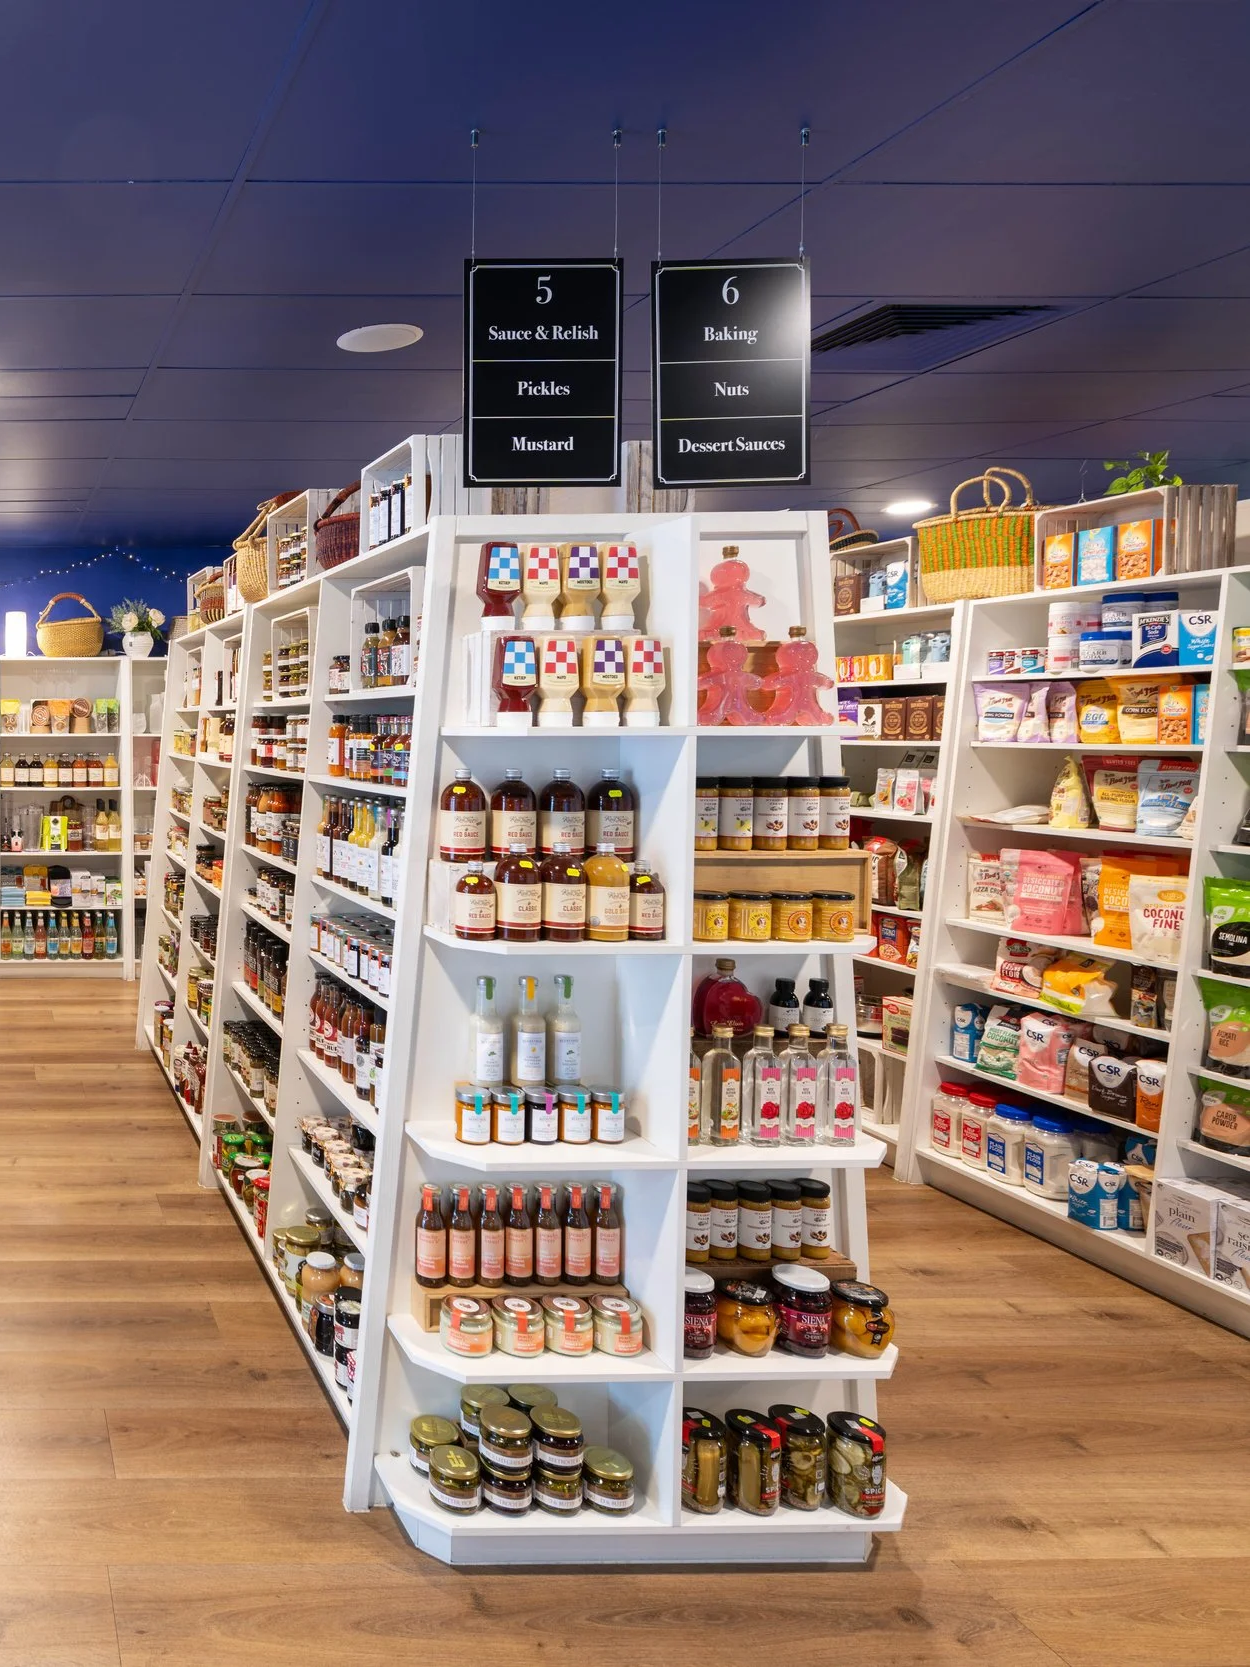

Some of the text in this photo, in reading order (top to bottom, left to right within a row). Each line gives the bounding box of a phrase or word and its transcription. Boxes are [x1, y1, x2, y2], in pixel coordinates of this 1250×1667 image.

[536, 275, 552, 305] 5
[722, 276, 739, 305] 6
[488, 325, 599, 341] Sauce & Relish
[703, 327, 758, 344] Baking
[517, 381, 570, 396] Pickles
[714, 382, 749, 397] Nuts
[512, 436, 574, 451] Mustard
[678, 437, 785, 453] Dessert Sauces
[1188, 615, 1212, 626] CSR
[1021, 884, 1064, 895] COCONUT
[1152, 919, 1180, 930] FINE
[1218, 932, 1248, 944] SEMOLINA
[1026, 1030, 1045, 1044] CSR
[1097, 1063, 1121, 1077] CSR
[1139, 1074, 1160, 1087] CSR
[1216, 1110, 1238, 1122] CAROB
[1211, 1116, 1238, 1132] POWDER
[1070, 1173, 1089, 1187] CSR
[1168, 1206, 1196, 1223] plain
[1171, 1218, 1194, 1231] flour
[685, 1316, 709, 1326] SIENA
[802, 1314, 826, 1325] SIENA
